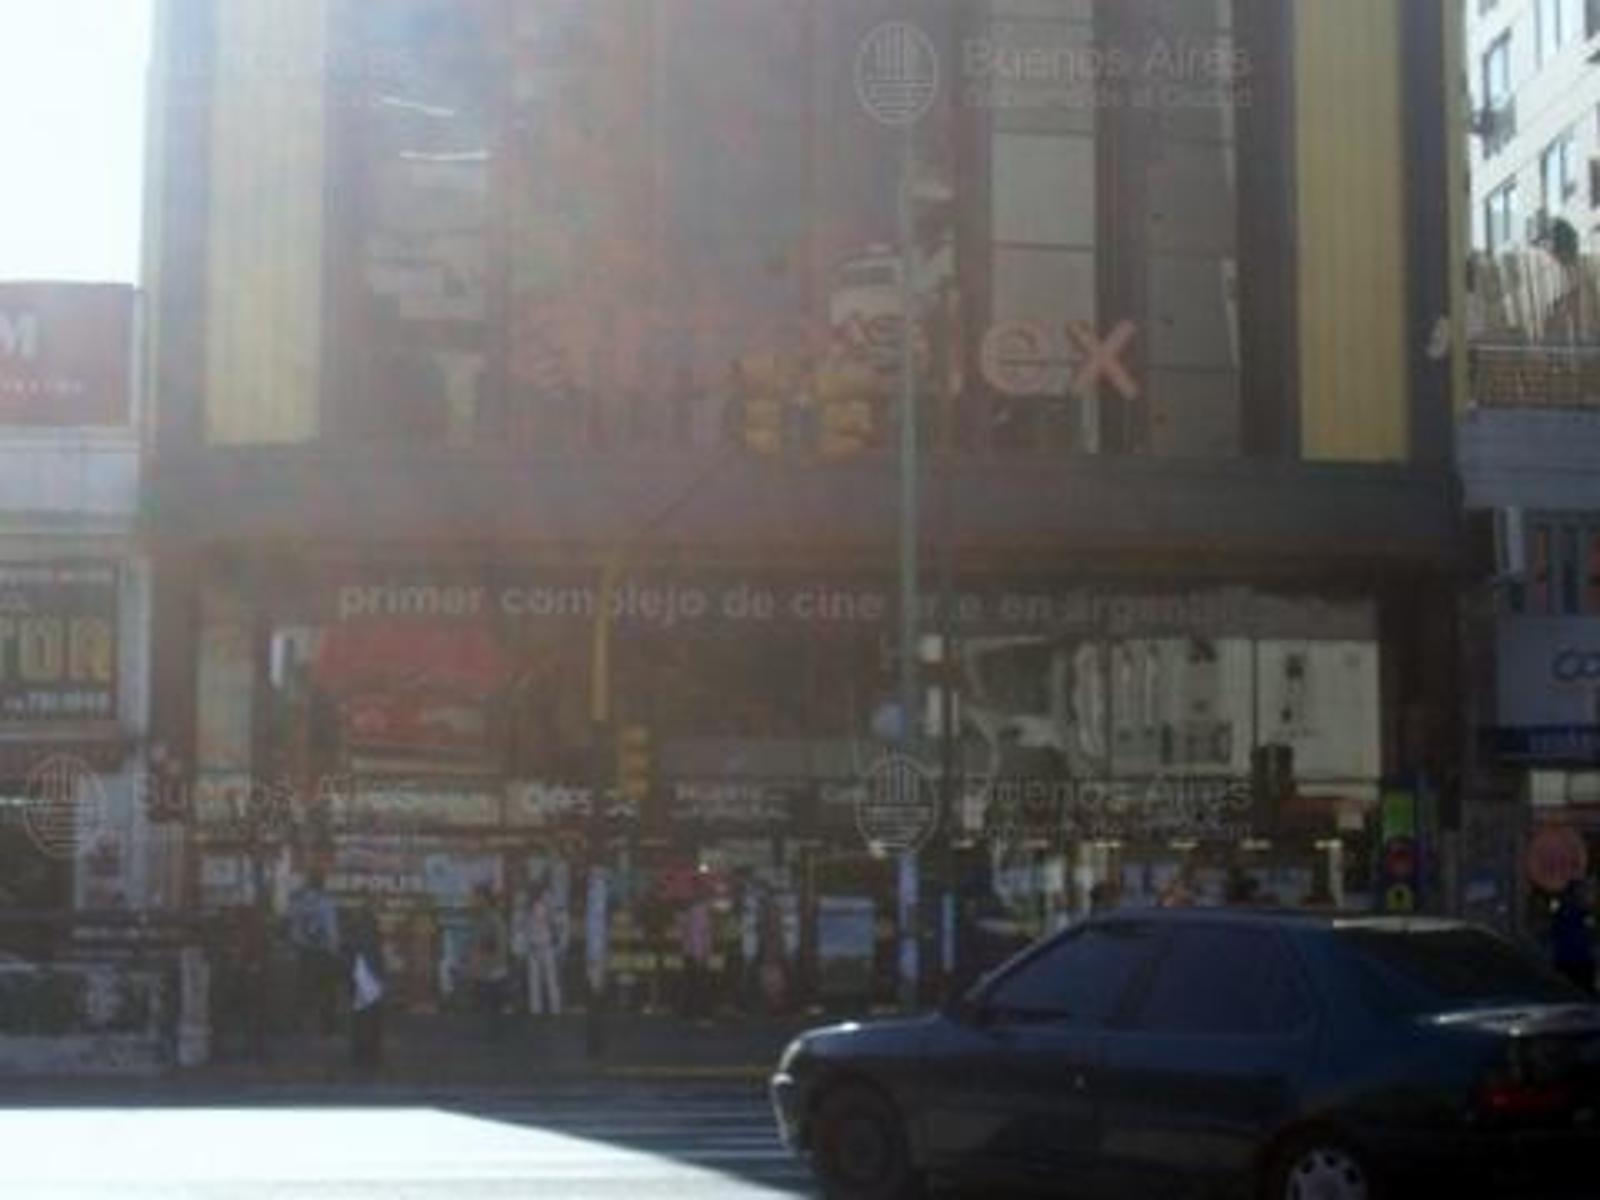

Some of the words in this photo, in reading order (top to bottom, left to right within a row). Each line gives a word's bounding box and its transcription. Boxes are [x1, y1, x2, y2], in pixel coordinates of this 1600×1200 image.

[339, 580, 483, 622] primer
[723, 579, 775, 620] de
[790, 584, 884, 622] cine
